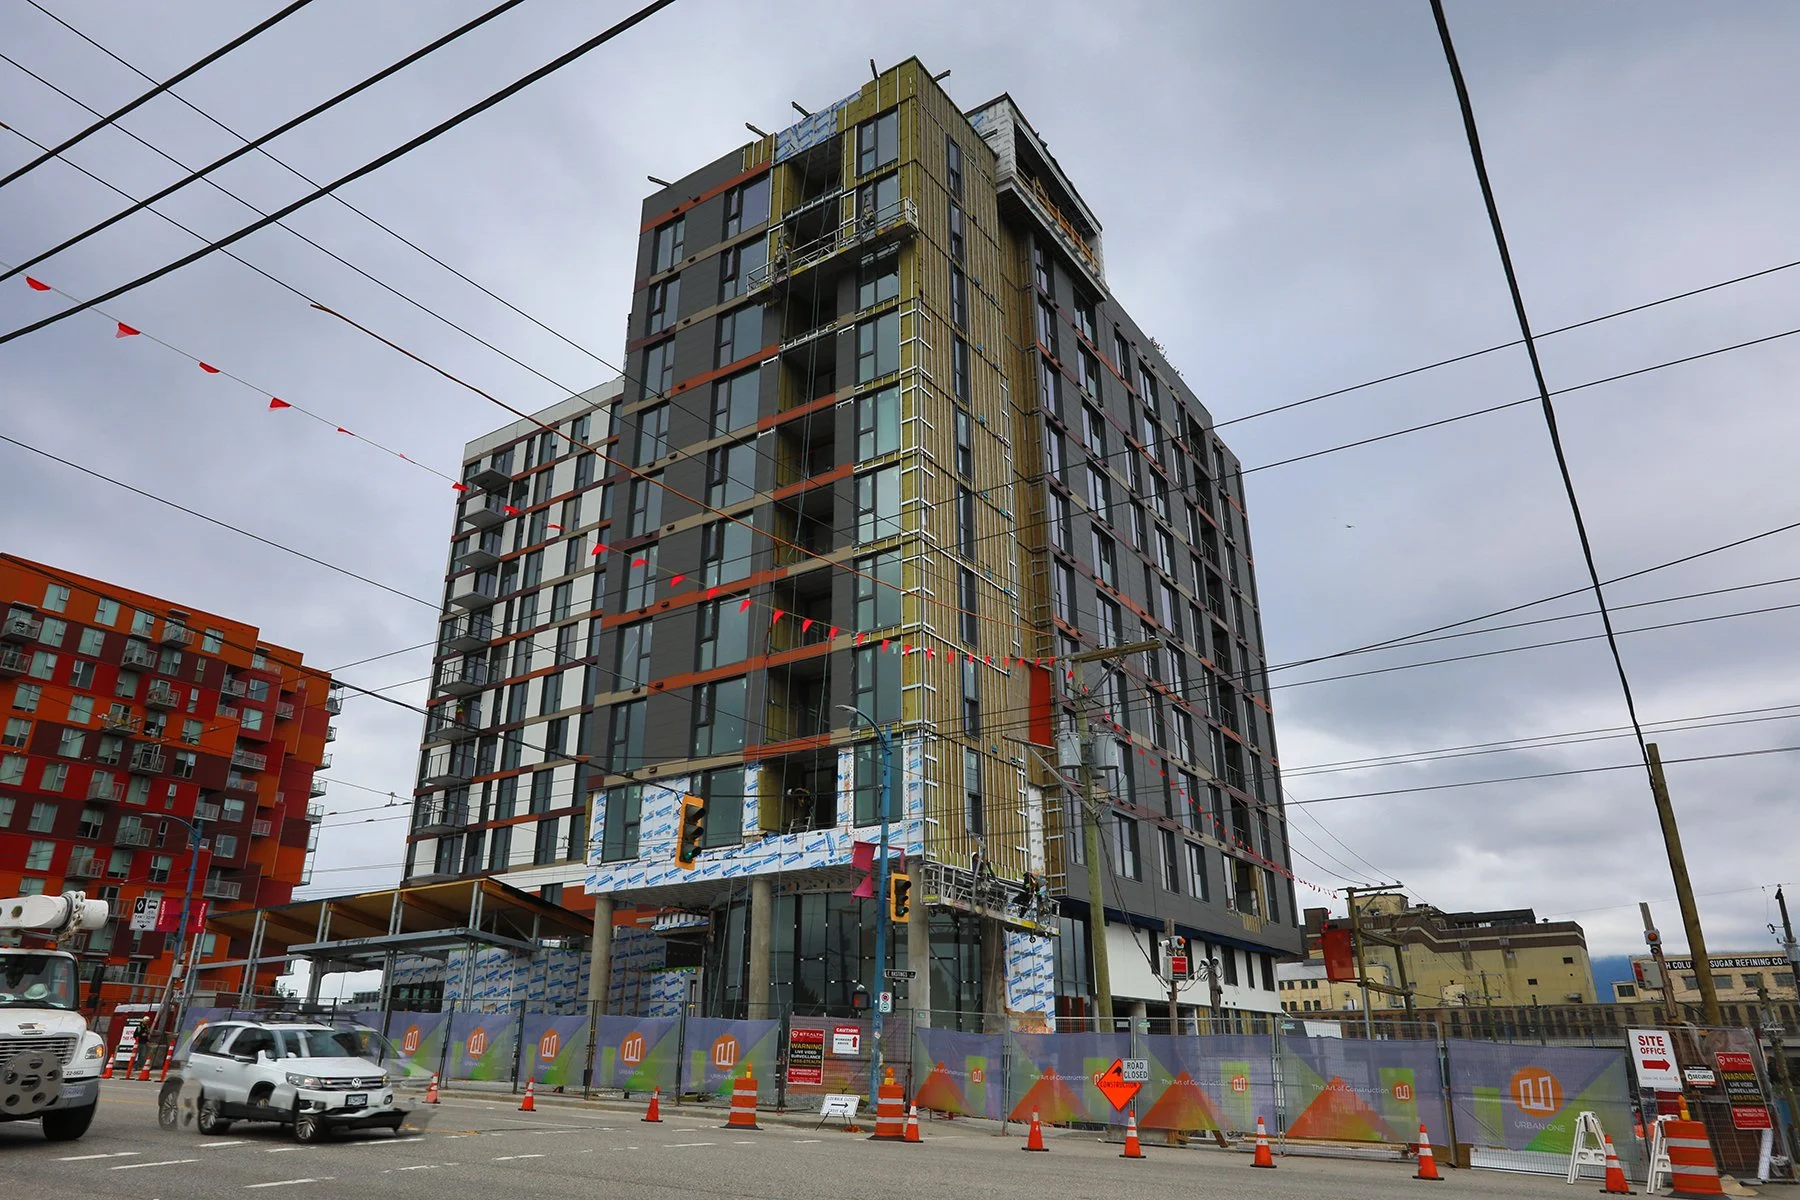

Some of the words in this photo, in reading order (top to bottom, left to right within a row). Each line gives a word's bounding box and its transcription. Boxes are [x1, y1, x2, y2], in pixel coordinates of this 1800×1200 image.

[1709, 960, 1734, 969] SUGAR
[1736, 958, 1770, 967] REFINING
[1772, 957, 1783, 966] CO
[1637, 1035, 1665, 1047] SITE
[1640, 1047, 1667, 1055] OFFICE
[1126, 1062, 1144, 1070] ROAD
[1123, 1071, 1148, 1079] CLOSED
[1100, 1081, 1138, 1089] CONSTRUCTION
[1337, 1084, 1344, 1092] of
[1345, 1085, 1389, 1094] Construction
[1514, 1120, 1545, 1130] URBAN
[1546, 1123, 1566, 1133] ONE
